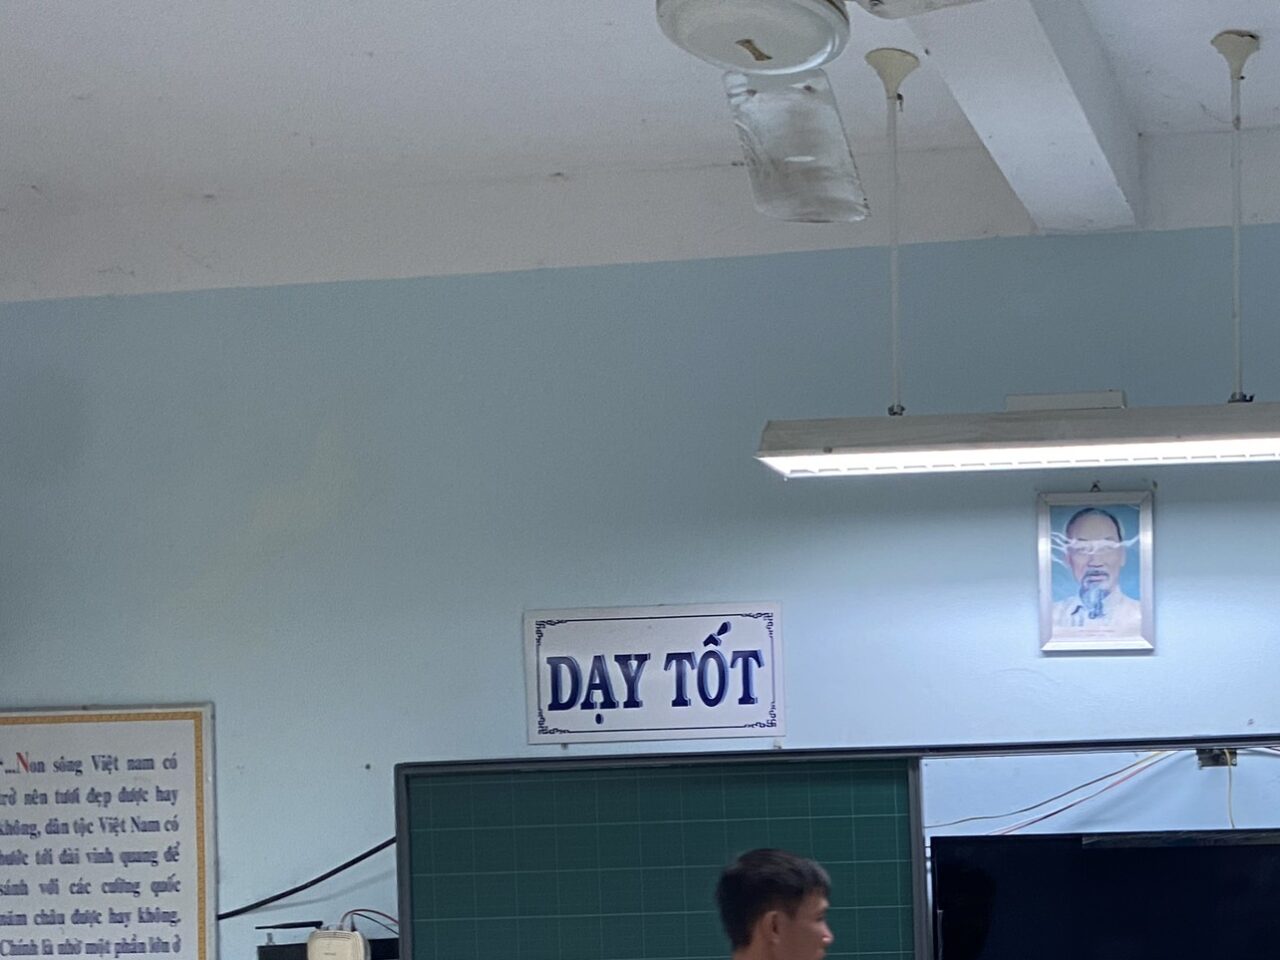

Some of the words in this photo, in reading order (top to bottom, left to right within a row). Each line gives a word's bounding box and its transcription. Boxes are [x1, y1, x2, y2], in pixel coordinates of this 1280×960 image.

[546, 653, 651, 725] DẠY
[663, 620, 765, 708] TỐT
[53, 756, 83, 776] sông
[91, 754, 119, 775] Việt
[162, 752, 178, 770] có
[24, 788, 48, 806] nên
[86, 786, 112, 808] đẹp
[118, 786, 149, 806] được
[156, 785, 178, 806] hay
[45, 817, 70, 836] dân
[73, 817, 94, 838] tộc
[98, 816, 126, 836] Việt
[131, 815, 161, 834] Nam
[164, 814, 180, 833] có
[69, 876, 92, 895] các
[150, 872, 182, 898] quốc
